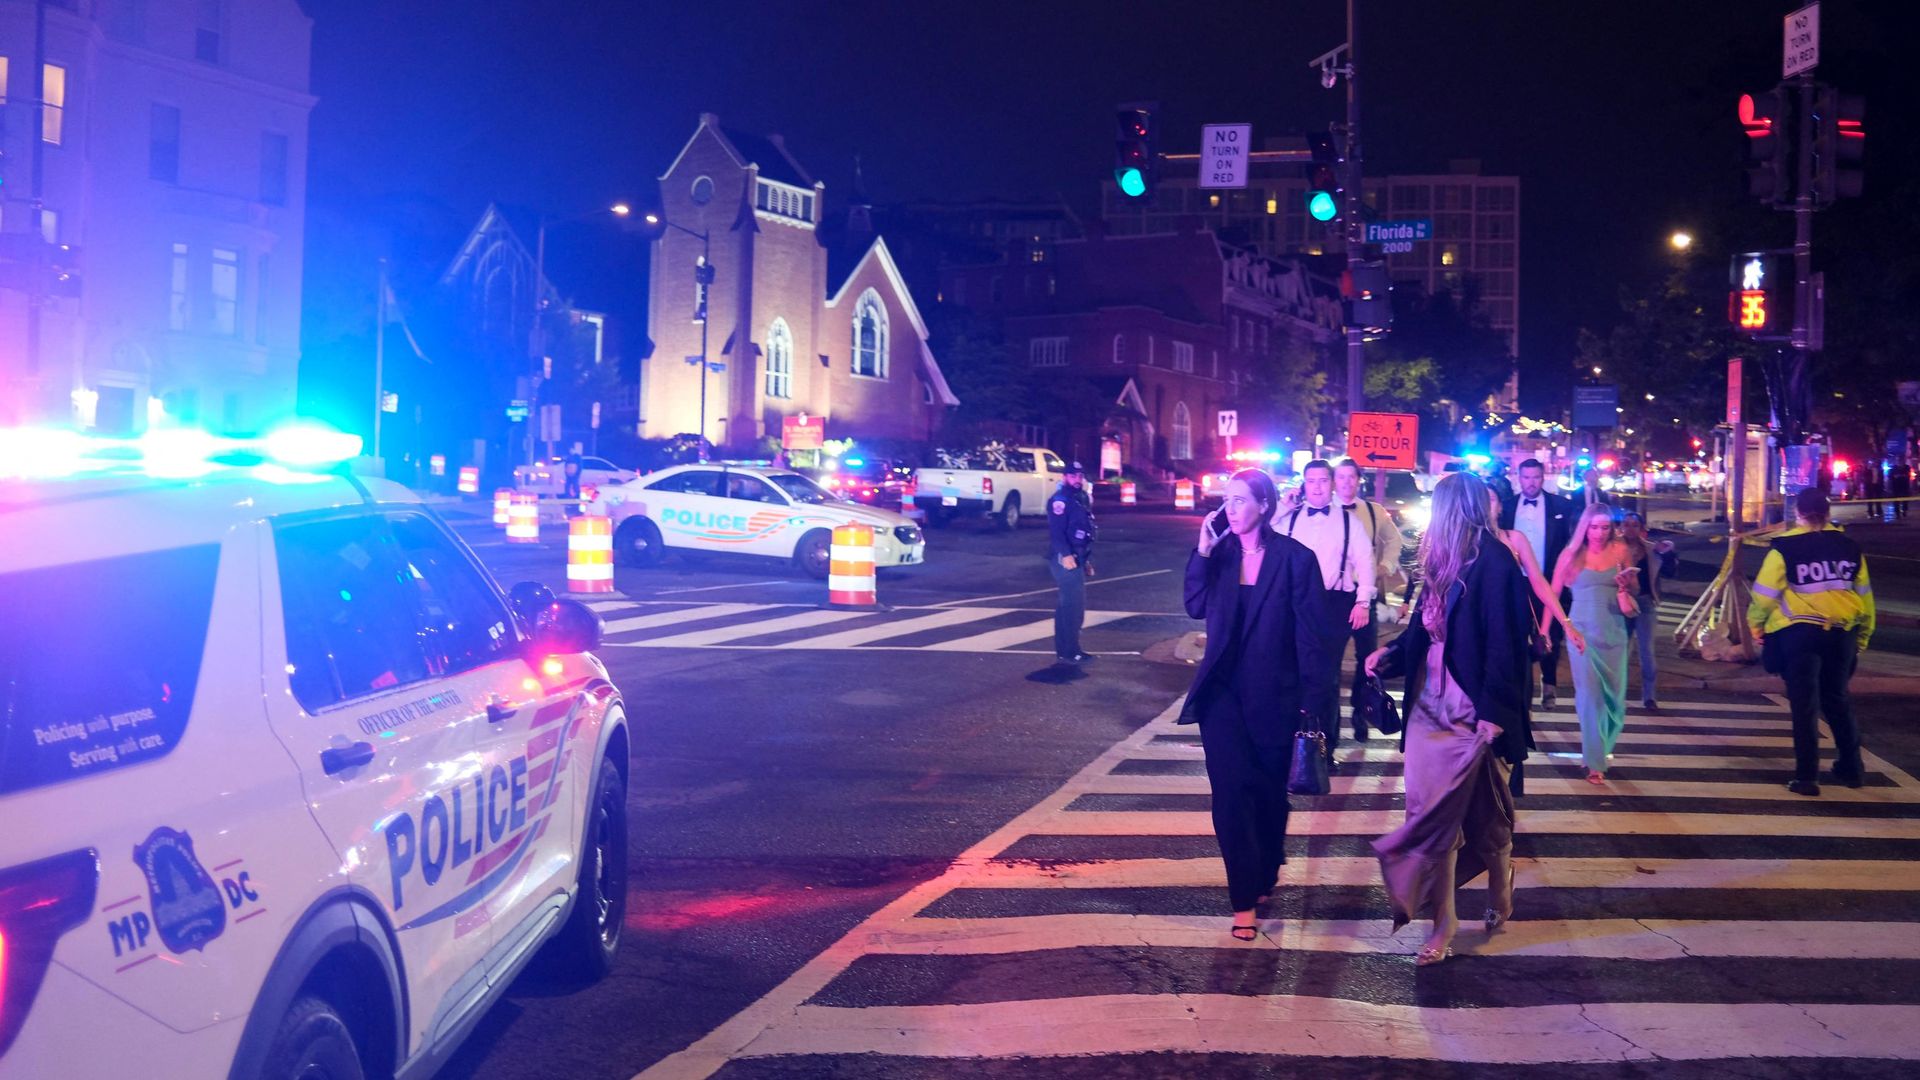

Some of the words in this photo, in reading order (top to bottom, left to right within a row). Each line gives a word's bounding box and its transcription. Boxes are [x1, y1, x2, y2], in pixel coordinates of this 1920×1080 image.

[1795, 15, 1808, 31] NO
[1791, 32, 1811, 49] TURN
[1787, 54, 1798, 69] ON
[1800, 47, 1815, 62] RED
[1216, 130, 1238, 142] NO
[1212, 146, 1239, 156] TURN
[1216, 159, 1232, 169] ON
[1213, 173, 1234, 183] RED
[1369, 223, 1414, 240] Florida
[1382, 241, 1412, 254] 2000
[1353, 435, 1410, 450] DETOUR
[661, 507, 748, 532] POLICE
[357, 708, 405, 735] OFFICER
[400, 703, 417, 722] OF
[411, 698, 435, 717] THE
[428, 689, 462, 710] MONTH
[33, 722, 88, 745] Policing
[69, 745, 118, 767] Serving
[384, 755, 527, 912] POLICE
[222, 871, 259, 909] DC
[107, 911, 150, 957] MP
